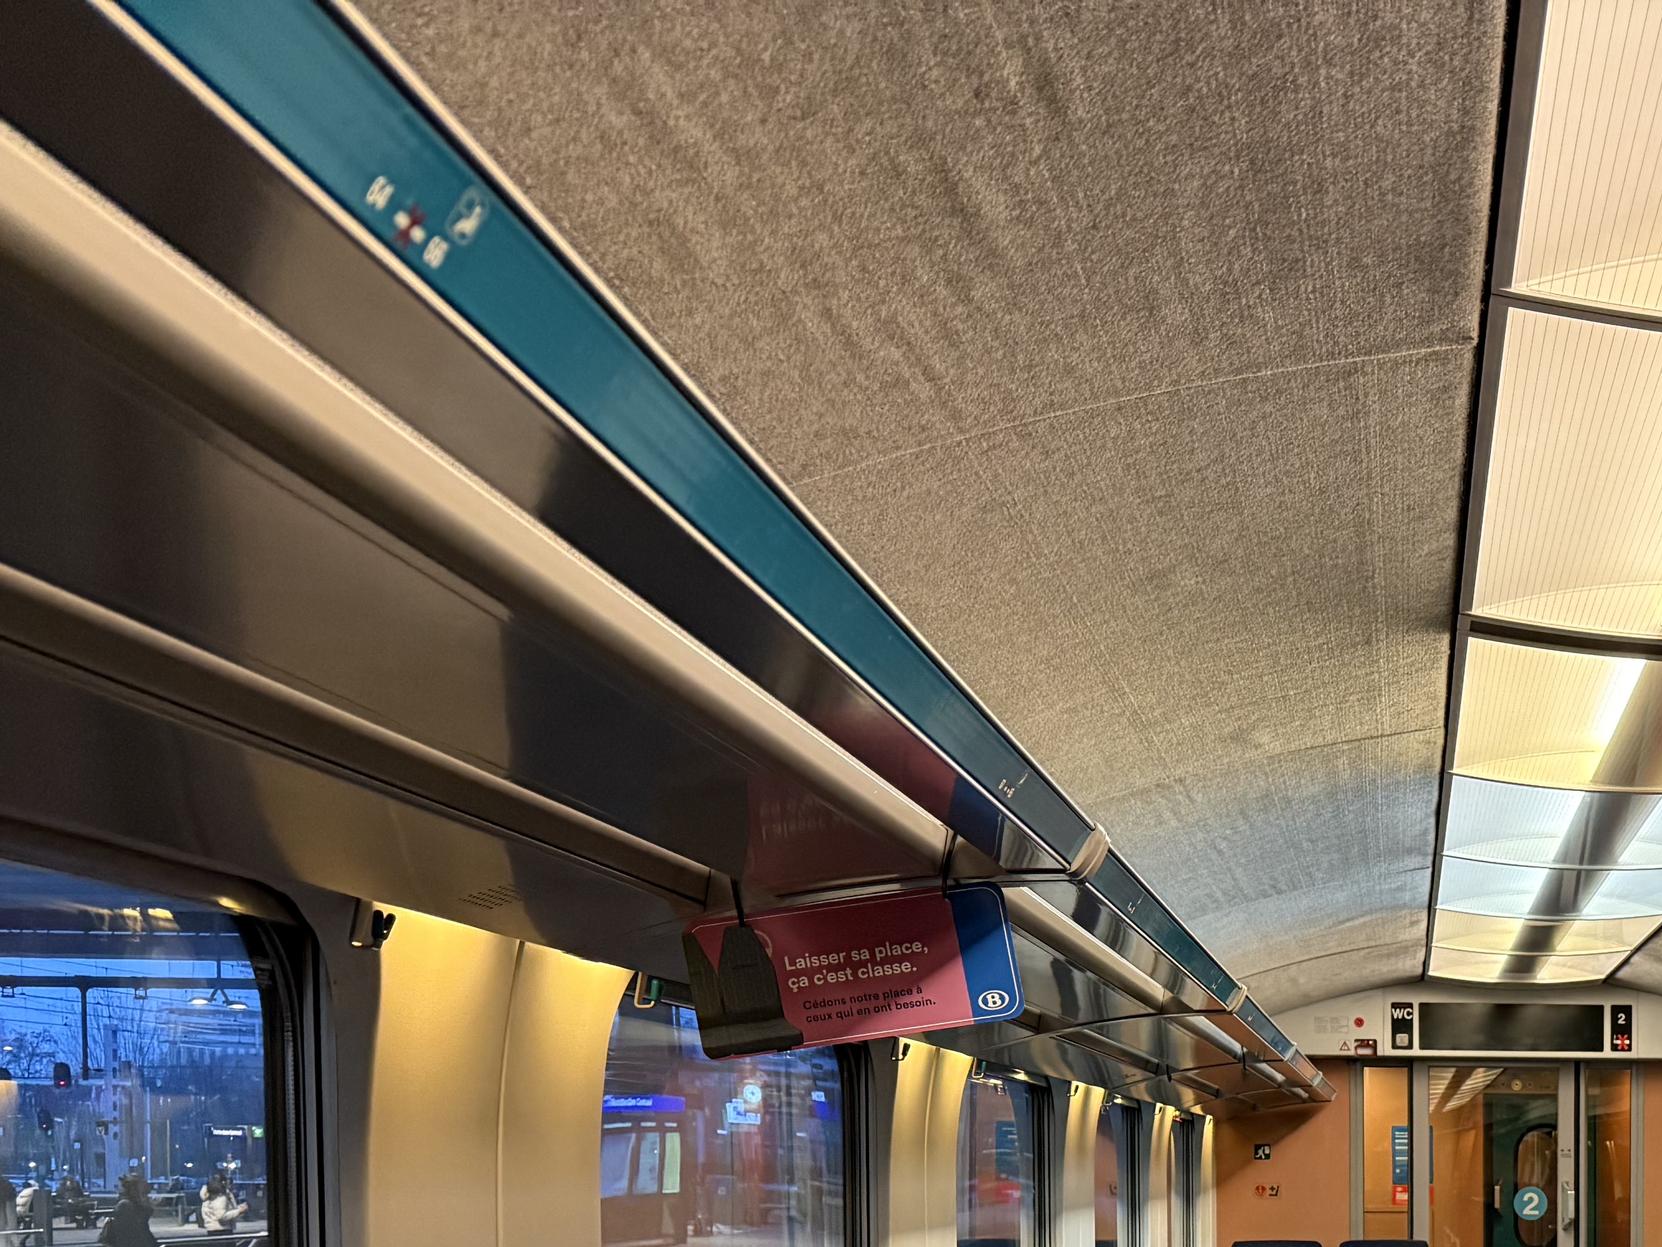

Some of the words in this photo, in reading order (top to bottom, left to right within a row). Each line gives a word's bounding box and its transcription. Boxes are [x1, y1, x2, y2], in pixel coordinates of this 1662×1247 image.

[784, 950, 847, 971] Laisser
[851, 948, 870, 961] sa
[875, 940, 928, 961] place,
[788, 975, 809, 993] ça
[858, 961, 918, 980] classe.
[803, 997, 847, 1011] Cédons
[850, 992, 880, 1005] notre
[882, 986, 913, 1001] place
[916, 984, 923, 995] à
[806, 1012, 833, 1024] ceux
[836, 1008, 854, 1021] qui
[857, 1005, 871, 1017] en
[873, 1002, 892, 1014] ont
[895, 996, 937, 1011] besoin.
[1391, 1008, 1413, 1020] WC
[1617, 1012, 1626, 1025] 2
[1521, 1191, 1541, 1216] 2
